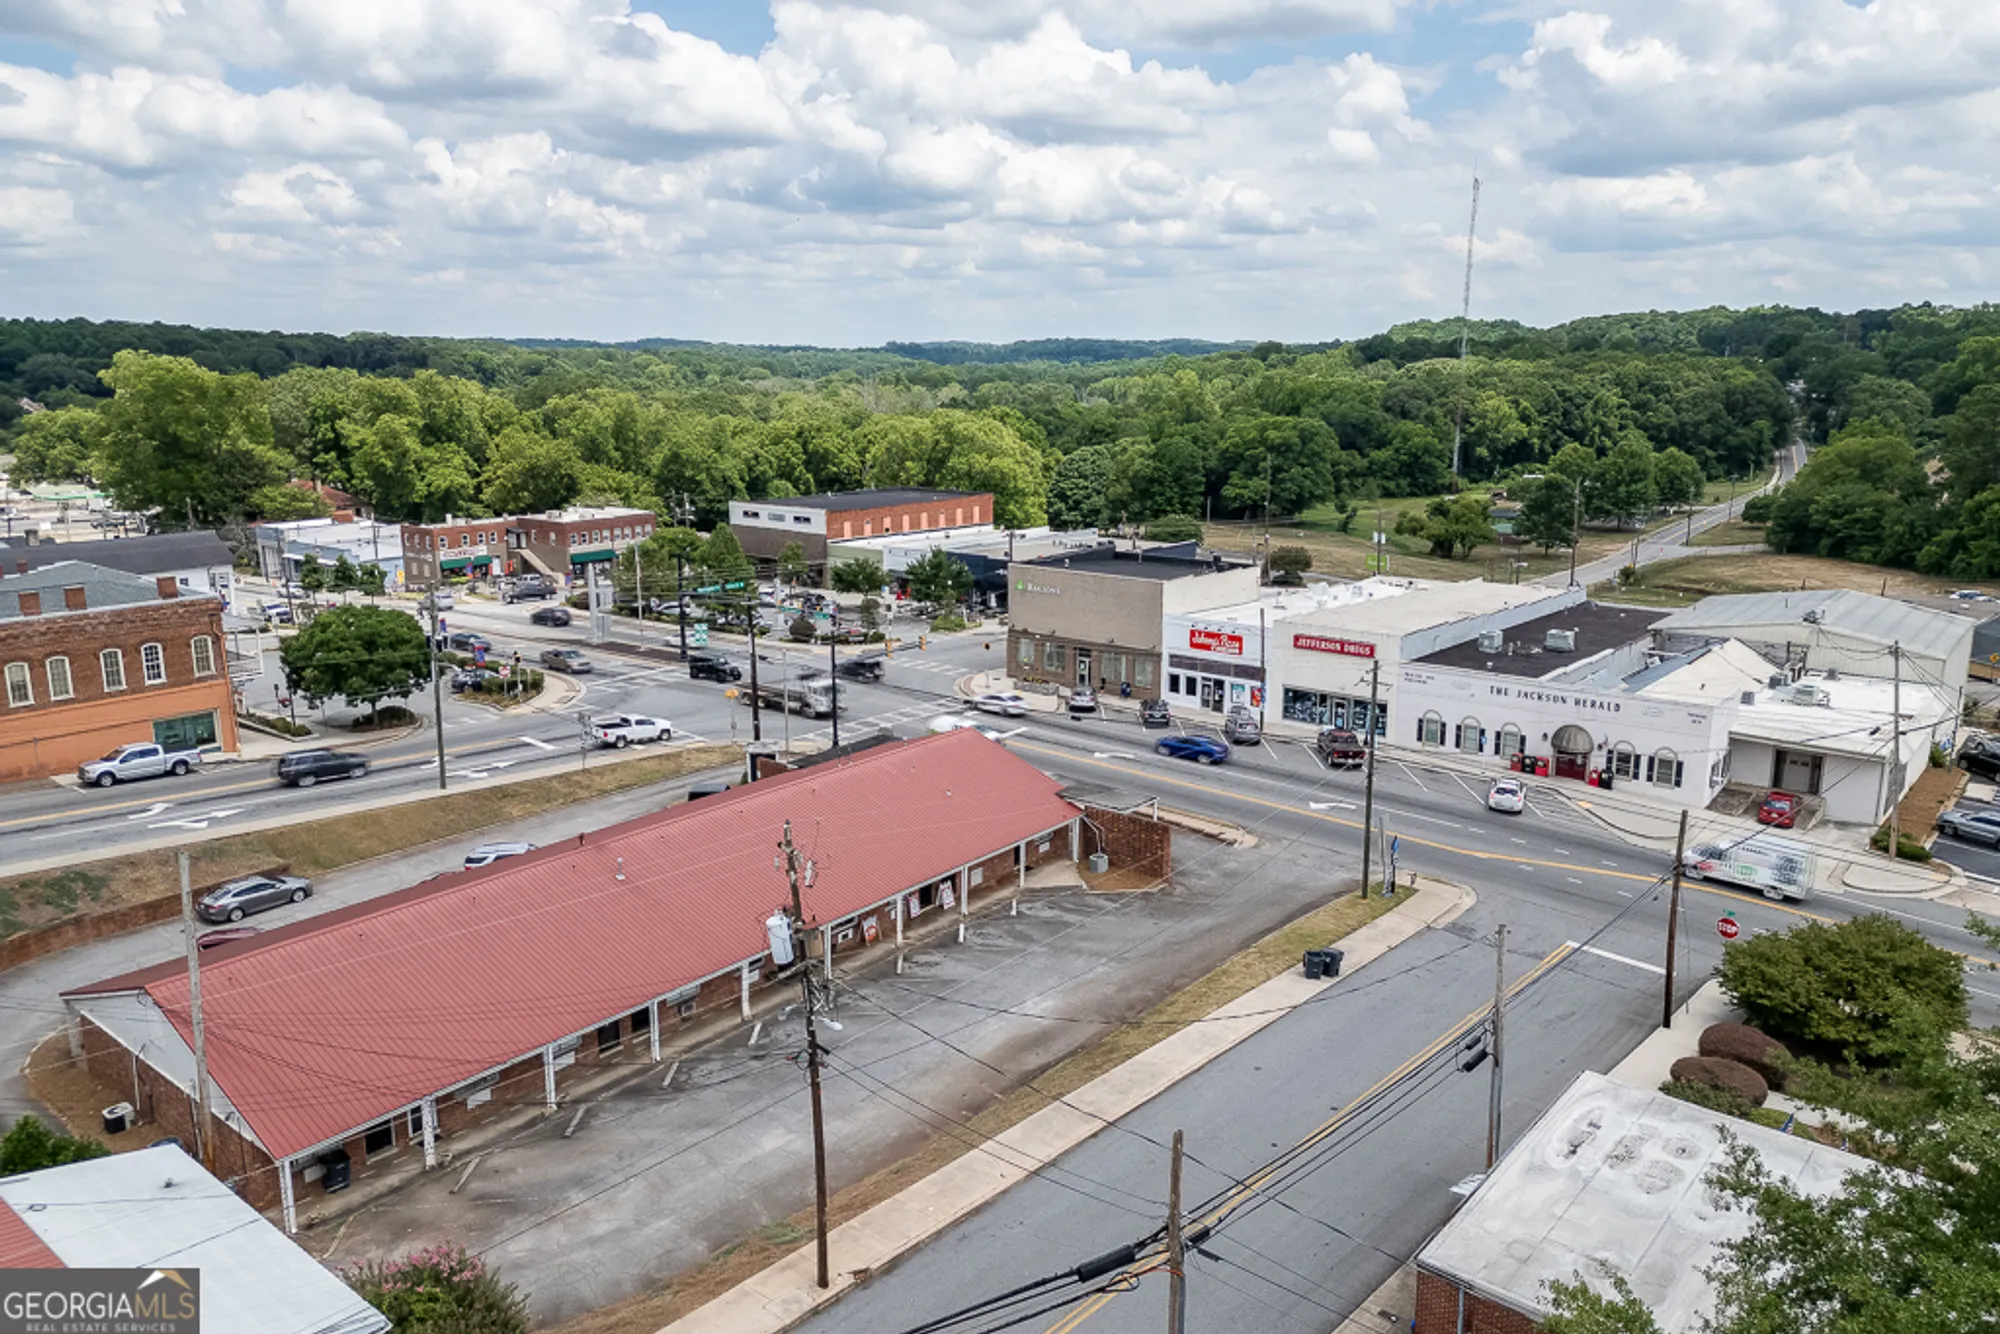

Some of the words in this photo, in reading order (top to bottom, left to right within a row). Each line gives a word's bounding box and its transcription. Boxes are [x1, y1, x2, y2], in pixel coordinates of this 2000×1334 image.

[1489, 685, 1509, 697] THE
[1517, 690, 1567, 705] JACKSON
[1574, 698, 1622, 713] HERALD
[1718, 922, 1739, 933] STOP
